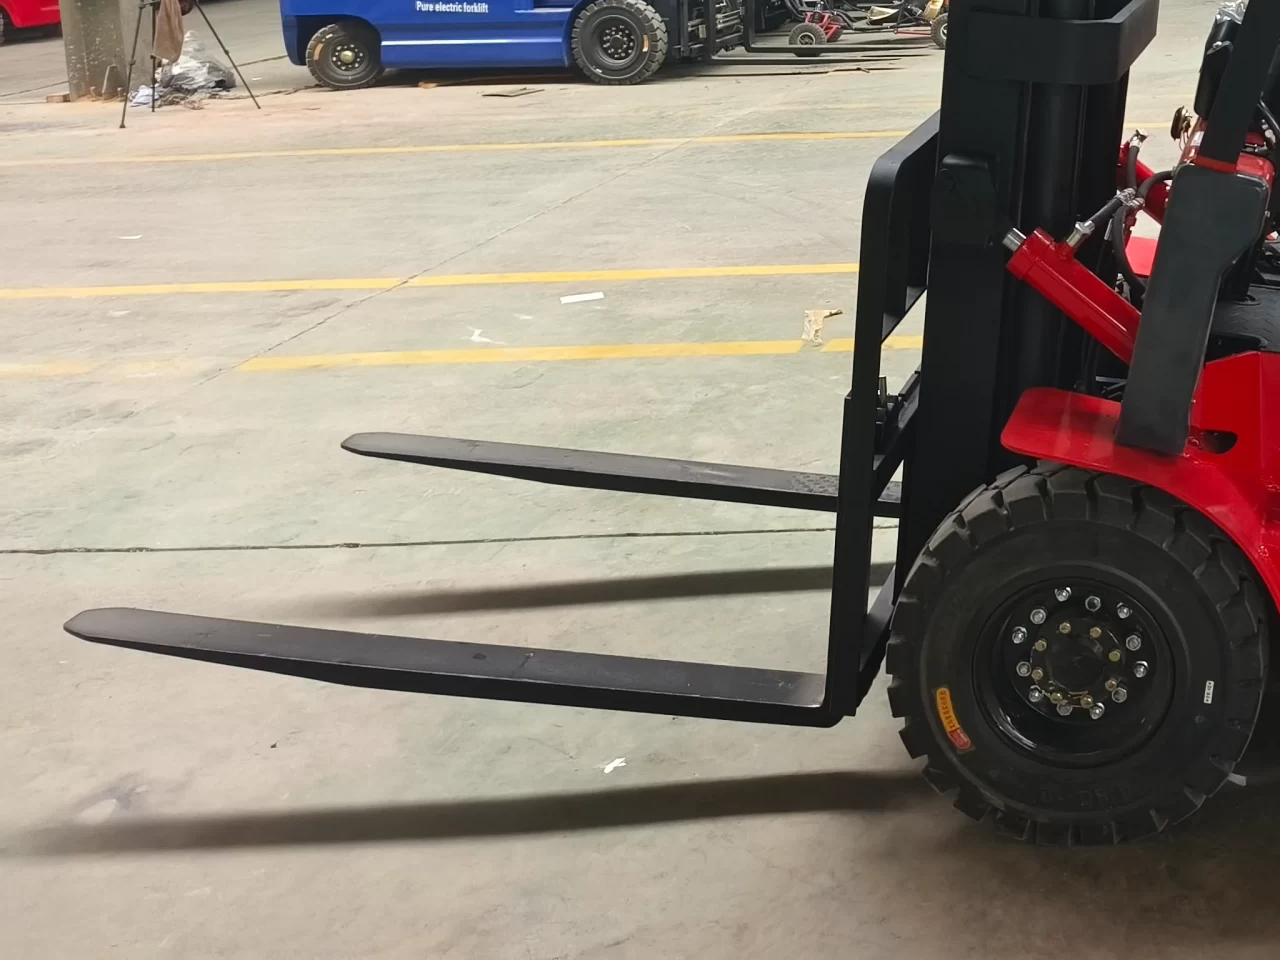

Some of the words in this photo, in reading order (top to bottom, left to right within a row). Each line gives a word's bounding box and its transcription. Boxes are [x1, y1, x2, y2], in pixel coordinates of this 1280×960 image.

[416, 1, 434, 12] Pure
[435, 1, 462, 13] electric
[463, 2, 489, 14] forklift
